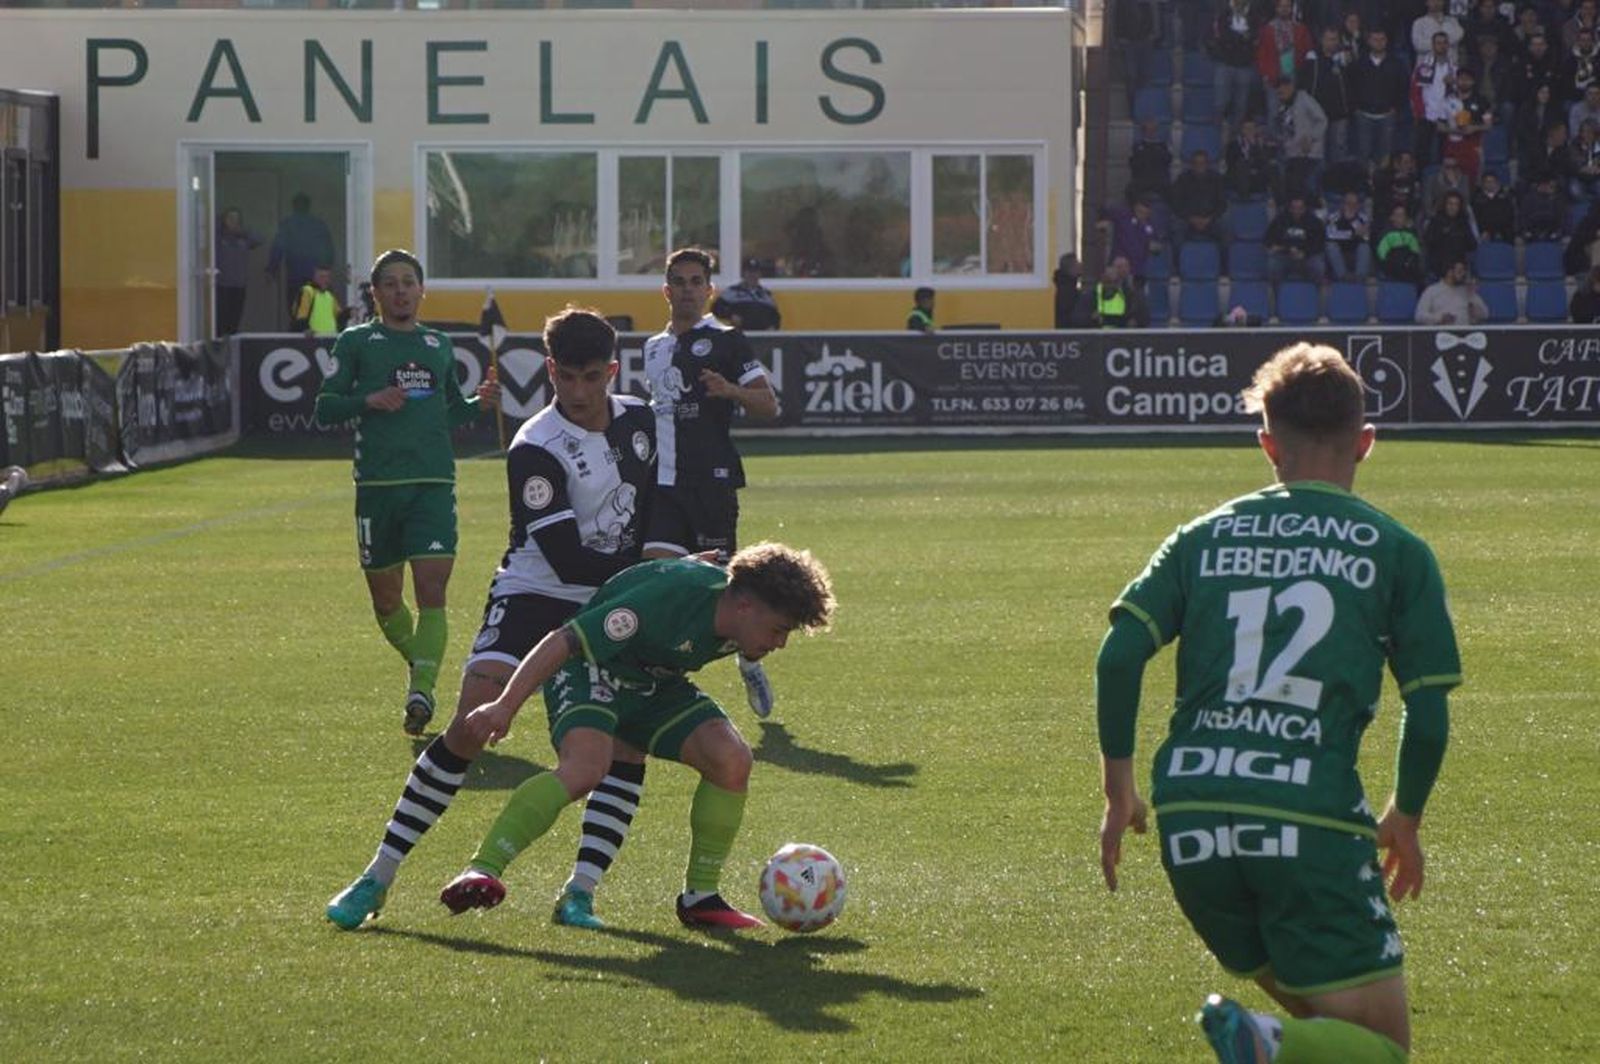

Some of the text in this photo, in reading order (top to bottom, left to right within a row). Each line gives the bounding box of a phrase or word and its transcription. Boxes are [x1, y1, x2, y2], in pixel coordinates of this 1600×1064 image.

[85, 38, 887, 159] PANELAIS
[937, 341, 1081, 360] CELEBRA TUS
[1106, 347, 1228, 378] Clínica
[805, 361, 915, 413] zielo
[960, 361, 1058, 380] EVENTOS
[932, 397, 1085, 411] TLFN. 633 07 26 84
[1212, 513, 1379, 546] PELICANO
[1199, 547, 1376, 589] LEBEDENKO
[1225, 581, 1335, 710] 12
[1167, 747, 1312, 785] DIGI
[1169, 824, 1299, 865] DIGI
